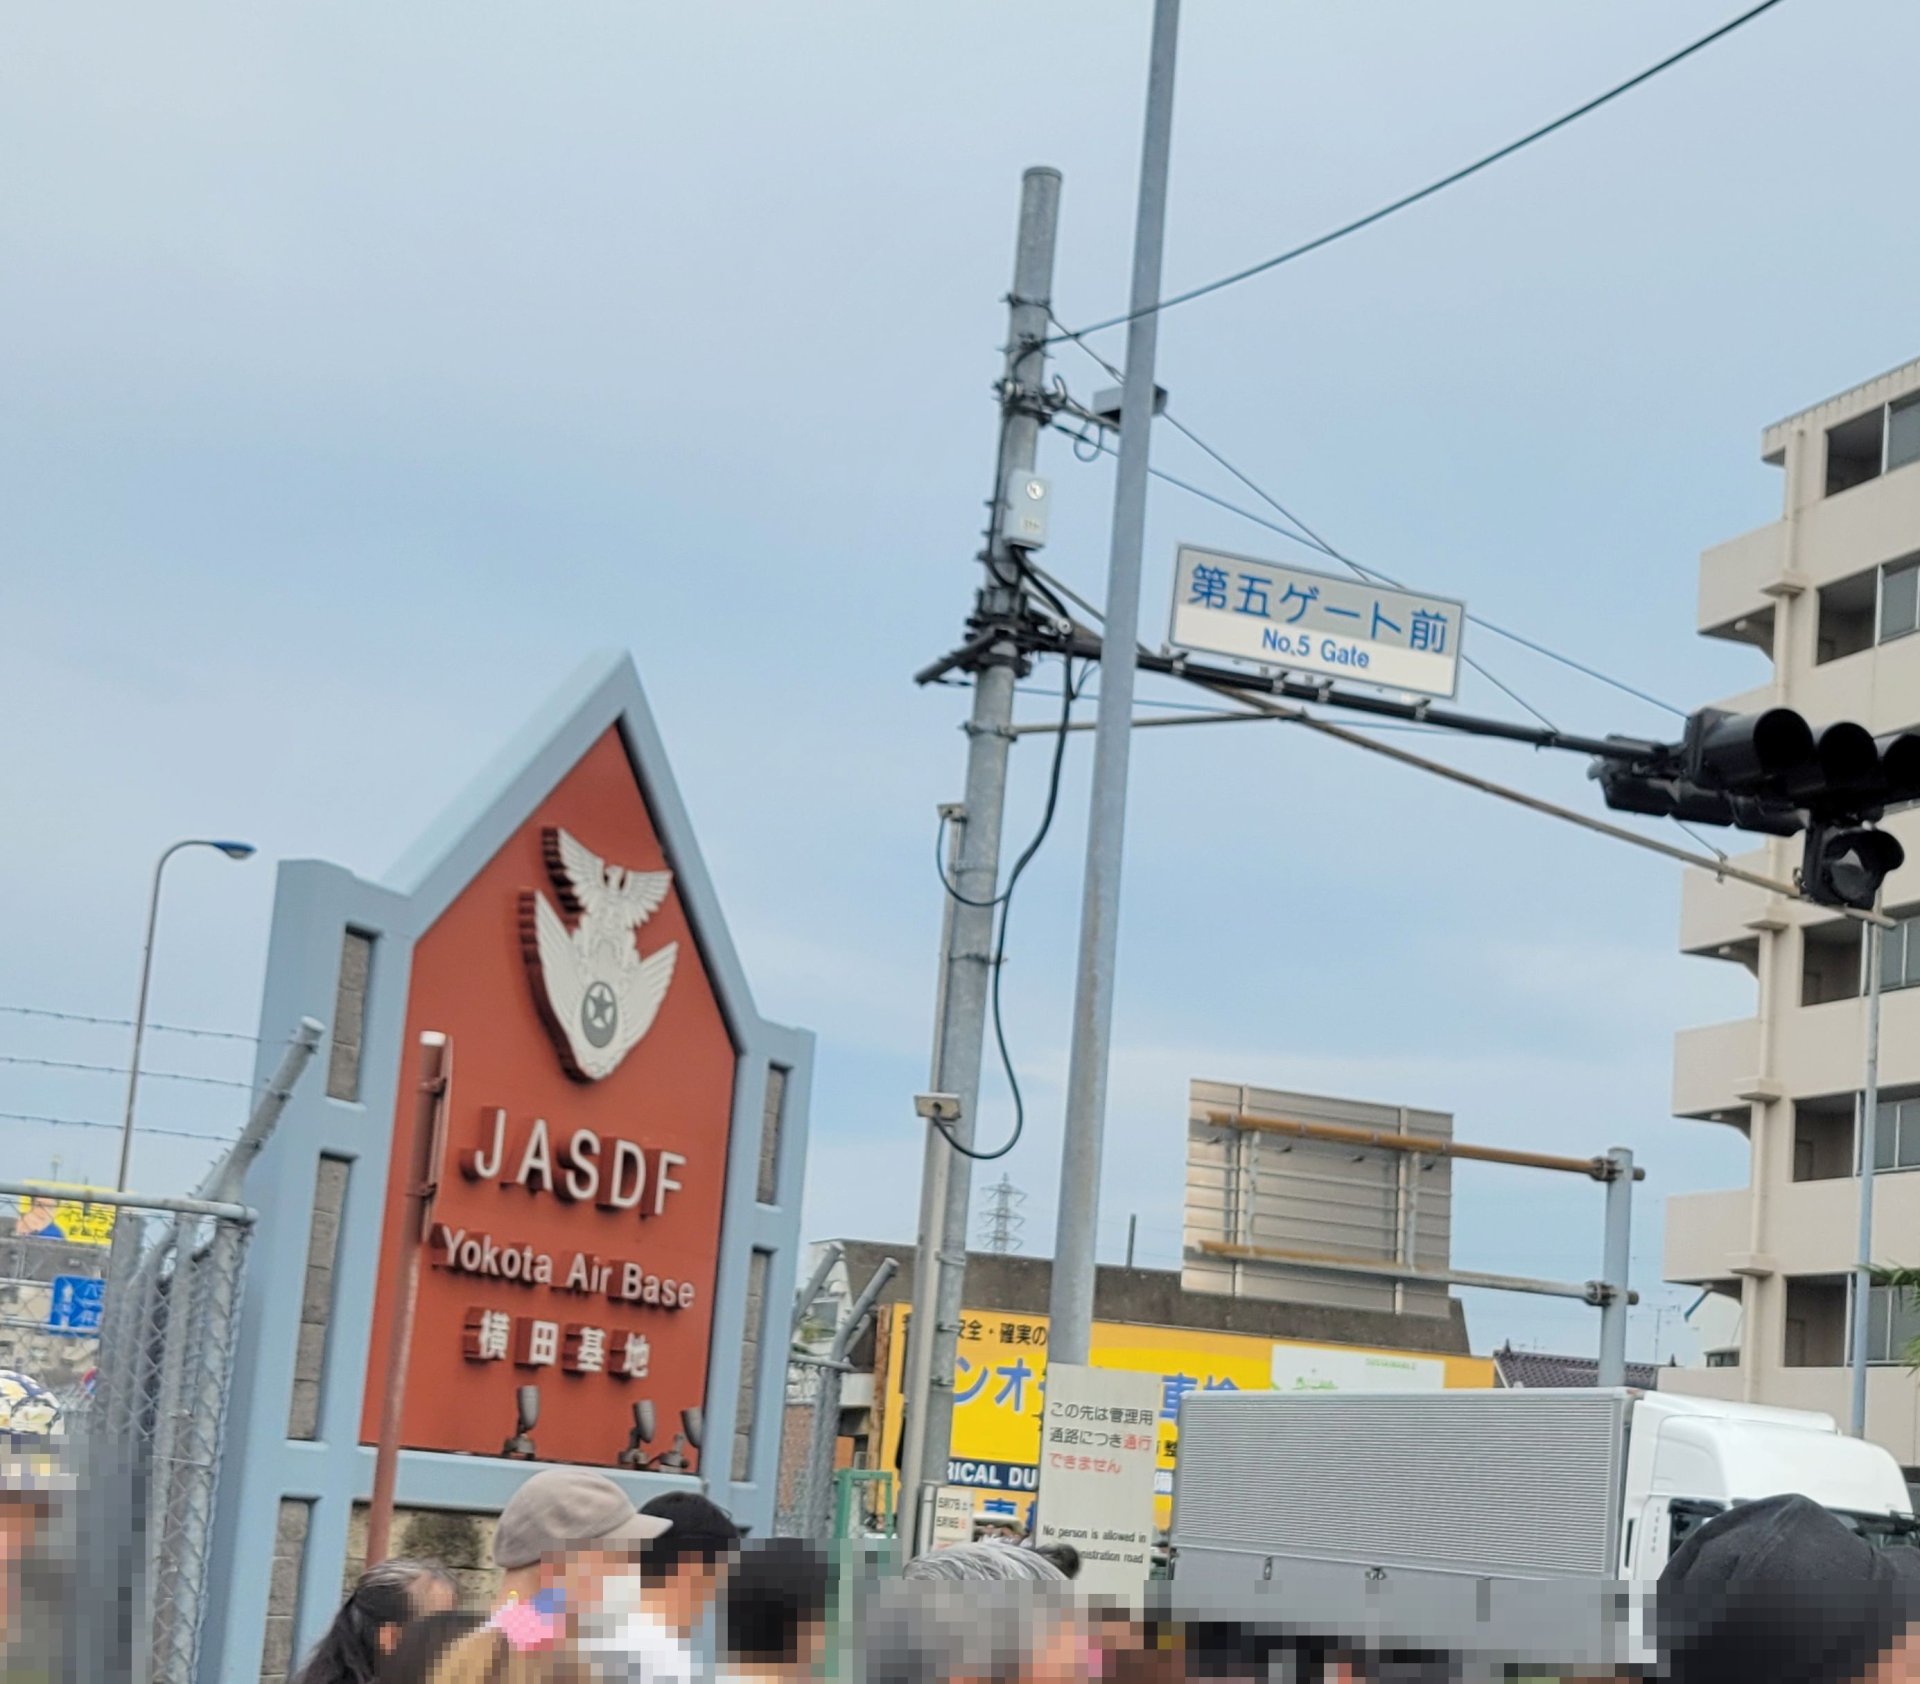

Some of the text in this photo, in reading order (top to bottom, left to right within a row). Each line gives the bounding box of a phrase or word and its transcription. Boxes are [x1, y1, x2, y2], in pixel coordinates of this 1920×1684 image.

[1187, 562, 1448, 654] 第五ゲート前
[1261, 627, 1370, 669] No.5 Gate
[474, 1108, 687, 1216] JASDF
[442, 1224, 696, 1308] Yokota Air Base
[478, 1308, 650, 1378] 横田基地
[953, 1356, 1239, 1419] ンオ 車
[1050, 1402, 1153, 1426] この先は管理用
[1049, 1426, 1152, 1451] 通路につき通行
[1049, 1452, 1122, 1474] できません
[1043, 1525, 1147, 1543] No person is allowed in
[1124, 1552, 1144, 1564] road
